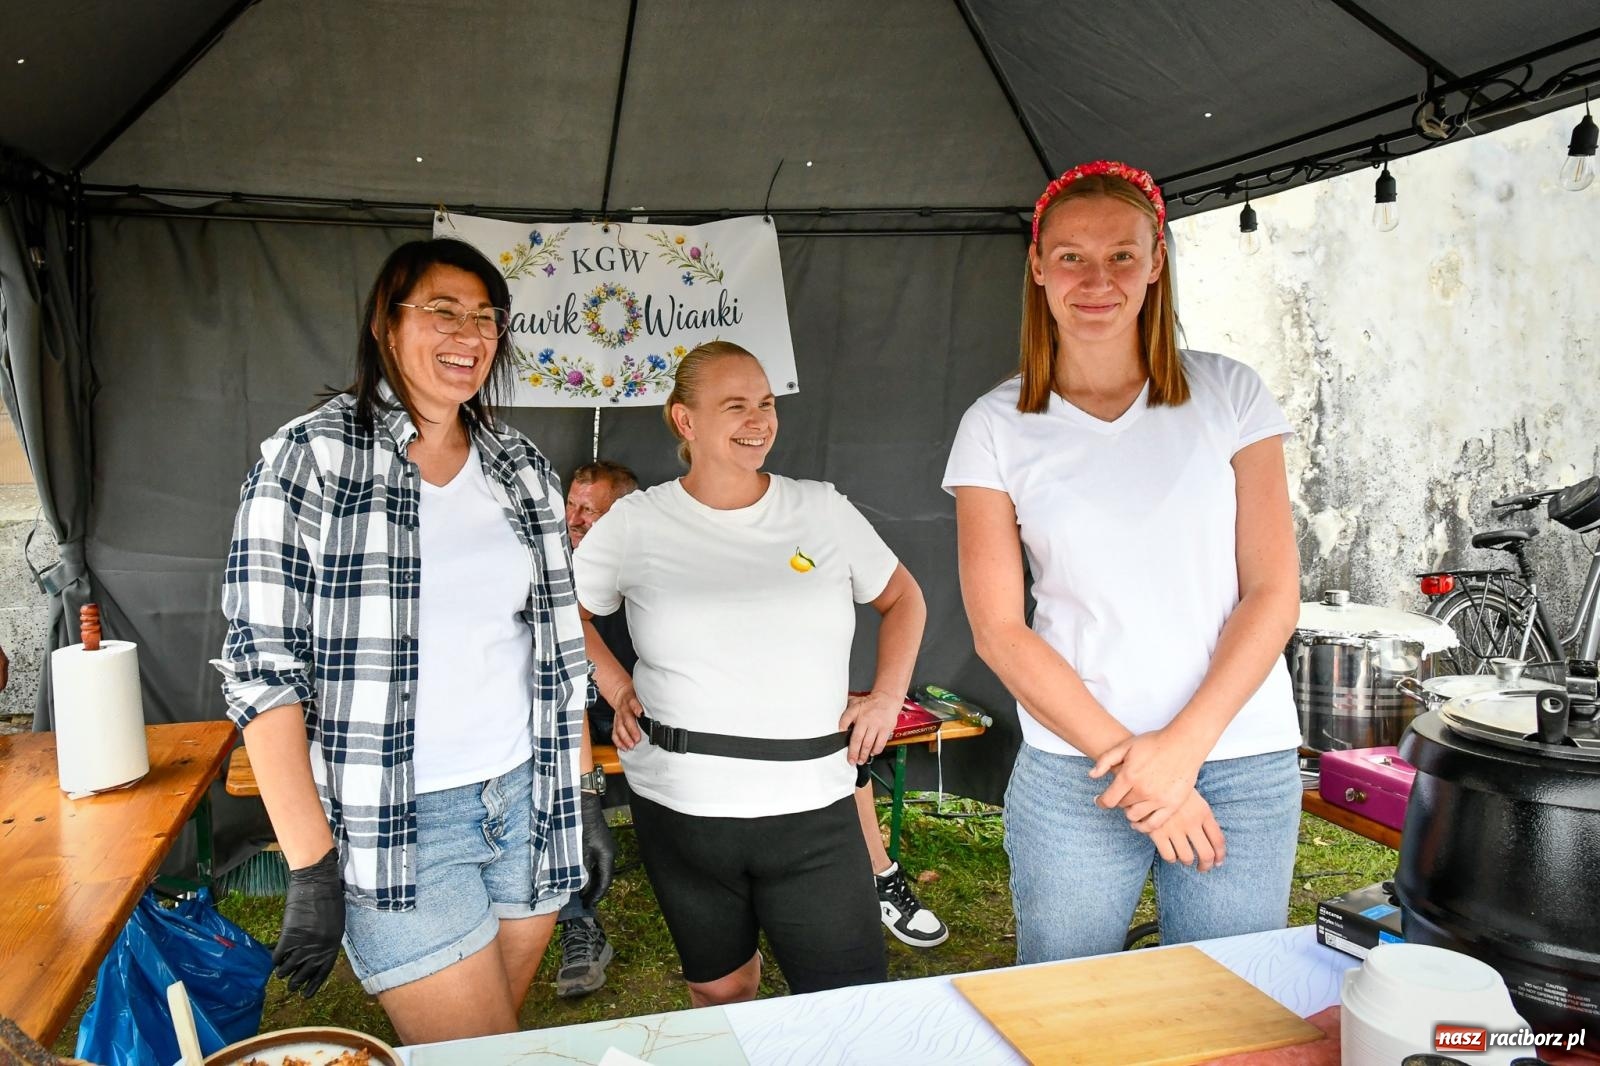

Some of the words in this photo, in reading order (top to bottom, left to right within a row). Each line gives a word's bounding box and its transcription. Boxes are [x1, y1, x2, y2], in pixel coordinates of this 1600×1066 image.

[571, 246, 650, 275] KGW
[644, 288, 744, 338] Wianki
[1545, 982, 1568, 992] CAUTION
